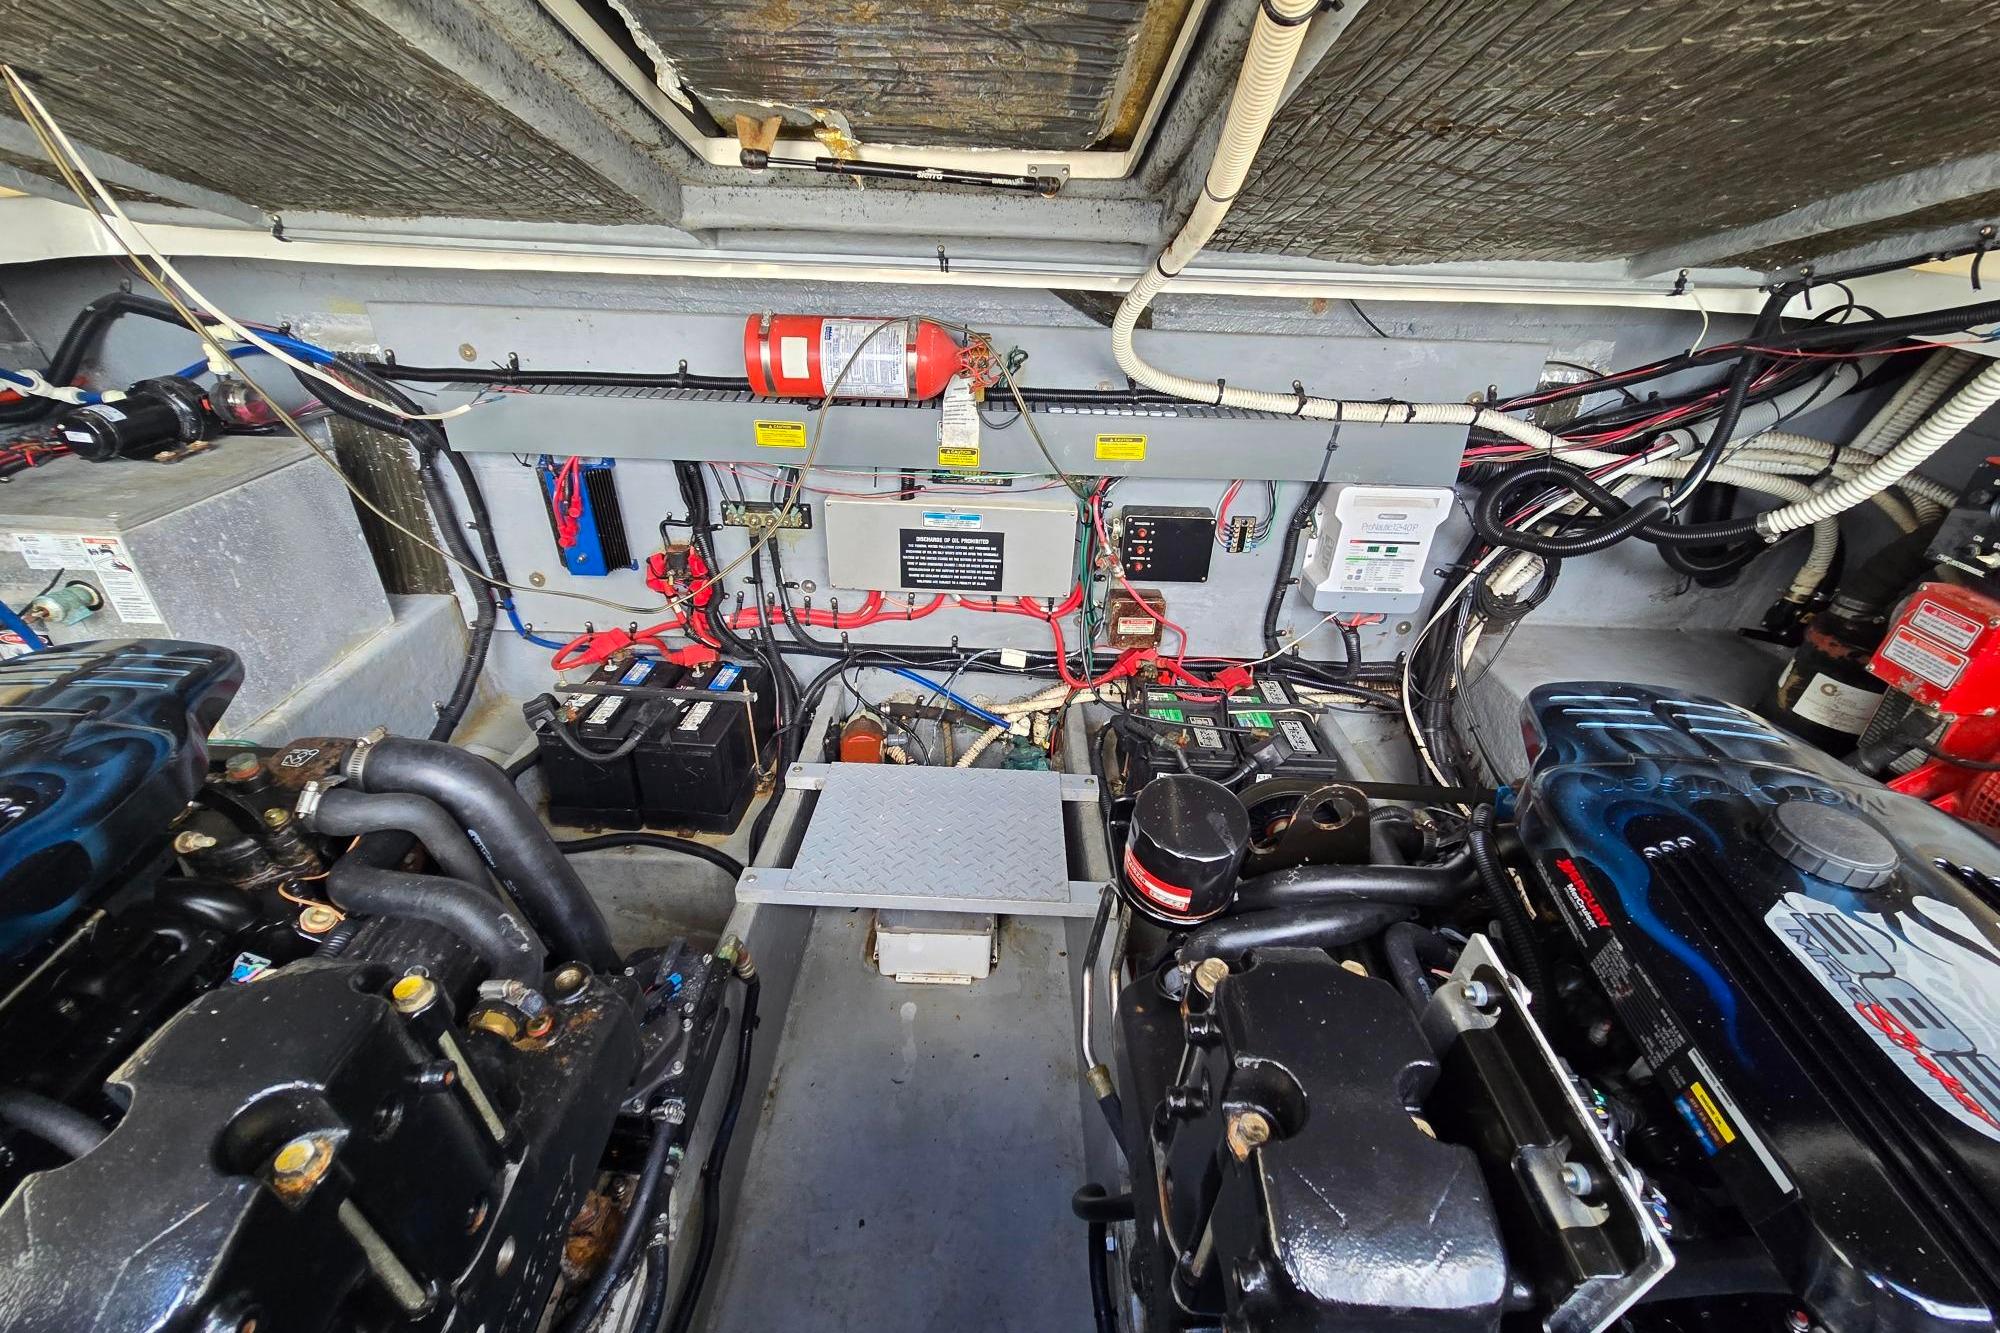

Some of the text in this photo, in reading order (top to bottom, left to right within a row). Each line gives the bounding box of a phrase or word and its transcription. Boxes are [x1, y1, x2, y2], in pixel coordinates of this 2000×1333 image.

[917, 170, 943, 180] Sierra
[1555, 859, 1612, 927] MERCURY
[1566, 883, 1598, 929] MerCruiser
[1785, 928, 1873, 1008] MAG
